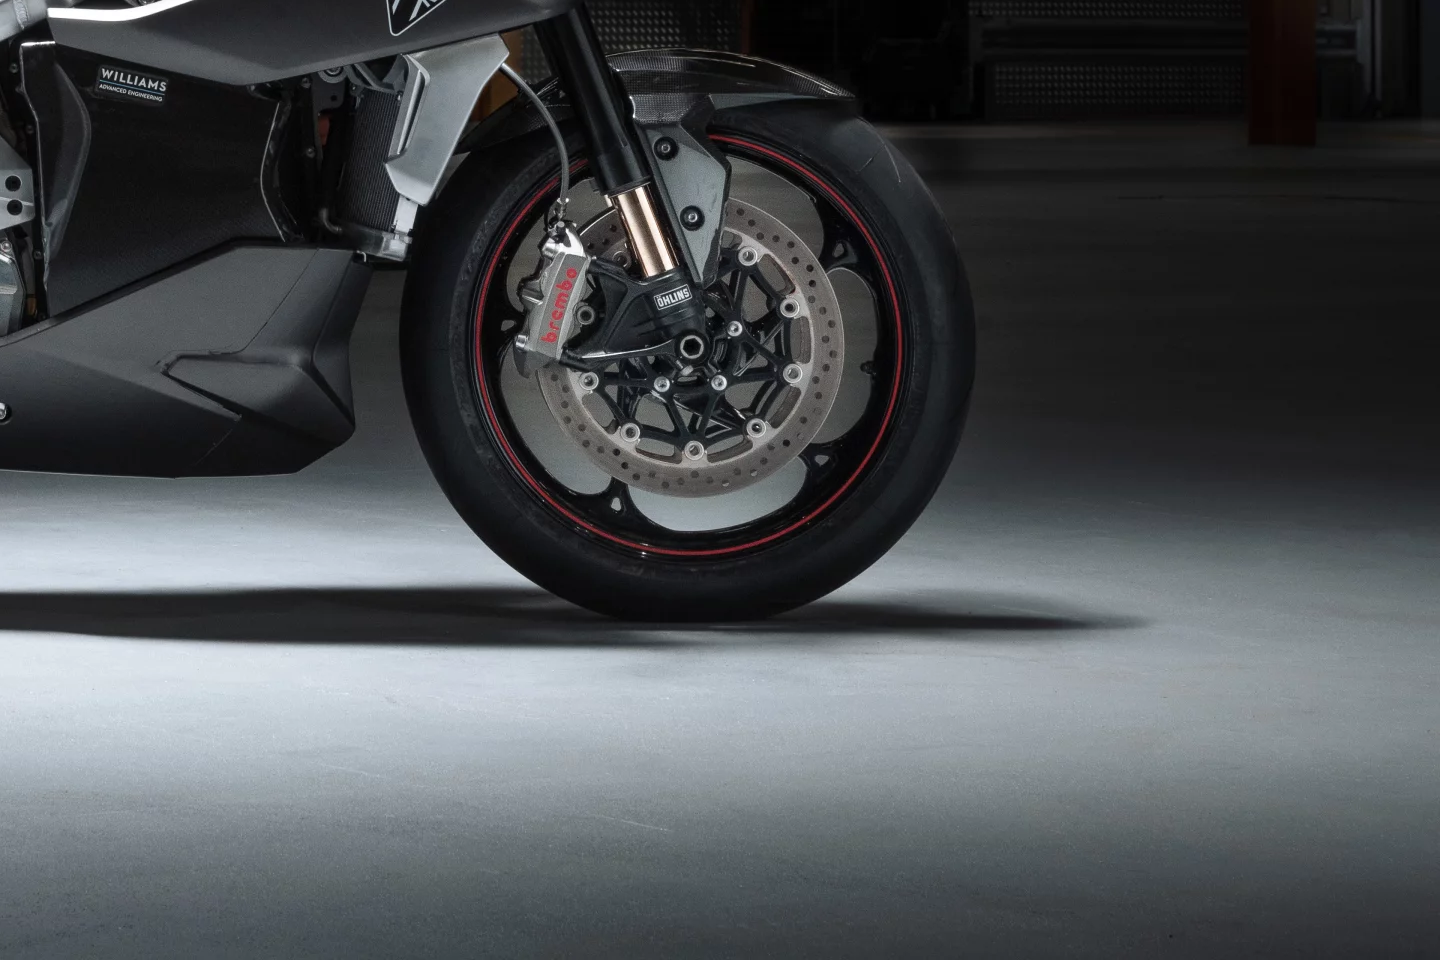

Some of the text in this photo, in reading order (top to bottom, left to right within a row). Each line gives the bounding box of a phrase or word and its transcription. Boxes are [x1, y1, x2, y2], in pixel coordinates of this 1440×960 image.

[101, 68, 167, 92] WILLIAMS
[99, 83, 163, 102] ADVANCED ENGINEERING
[540, 268, 577, 343] brembo
[656, 287, 691, 308] ÖHLINS
